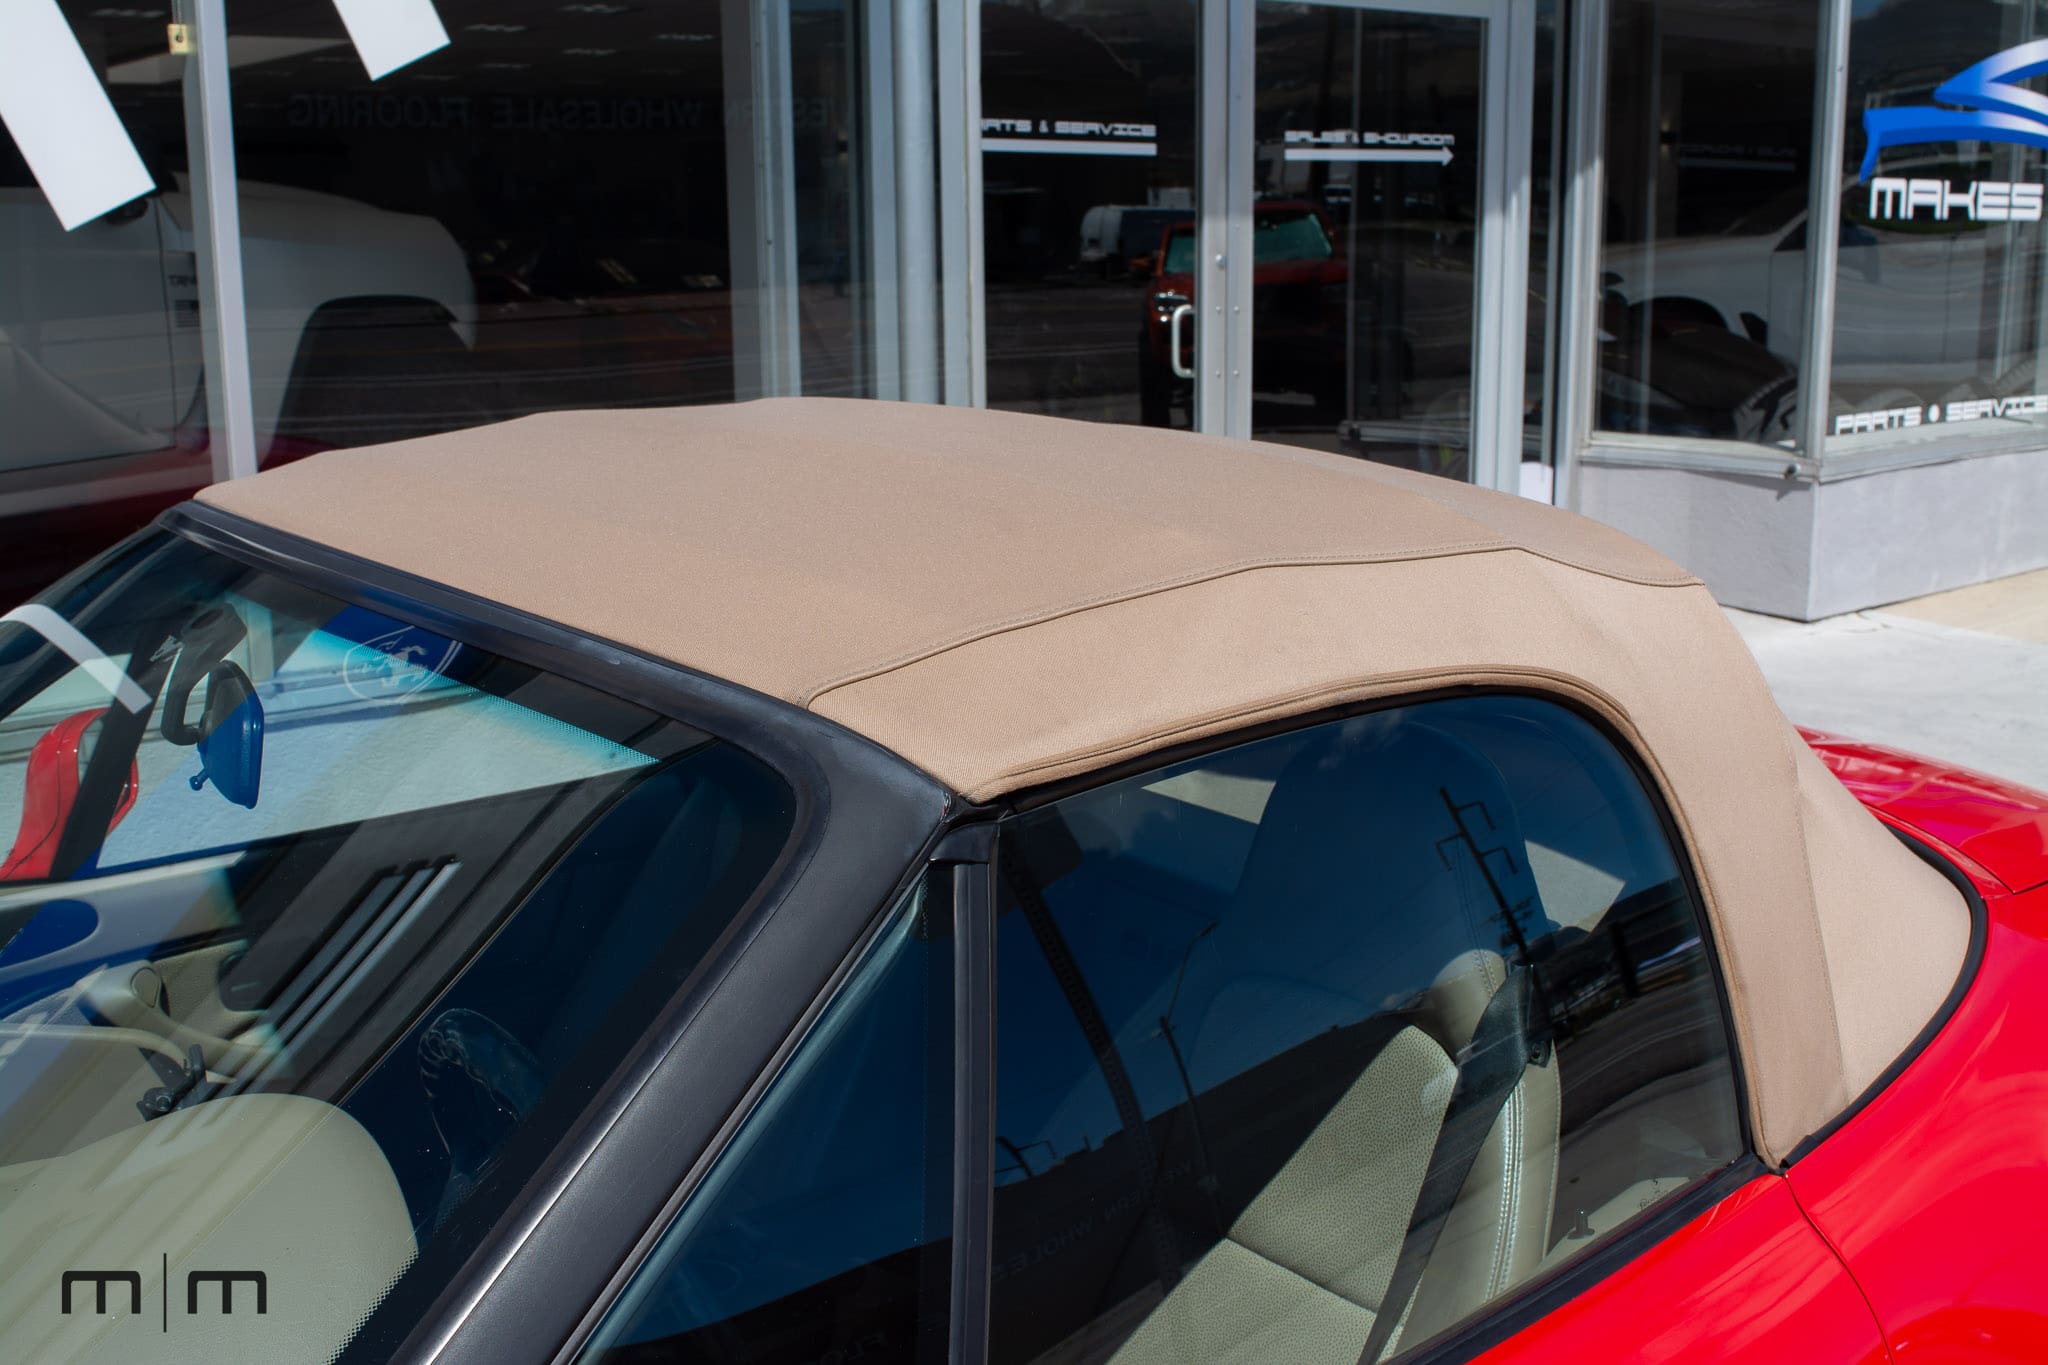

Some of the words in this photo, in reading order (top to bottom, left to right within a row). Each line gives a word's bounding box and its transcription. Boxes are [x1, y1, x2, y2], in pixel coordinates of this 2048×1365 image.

[1054, 121, 1157, 138] SERVICE
[1868, 176, 2044, 222] MAKES
[1834, 405, 1923, 437] PARTS
[1945, 394, 2048, 422] SERVICE
